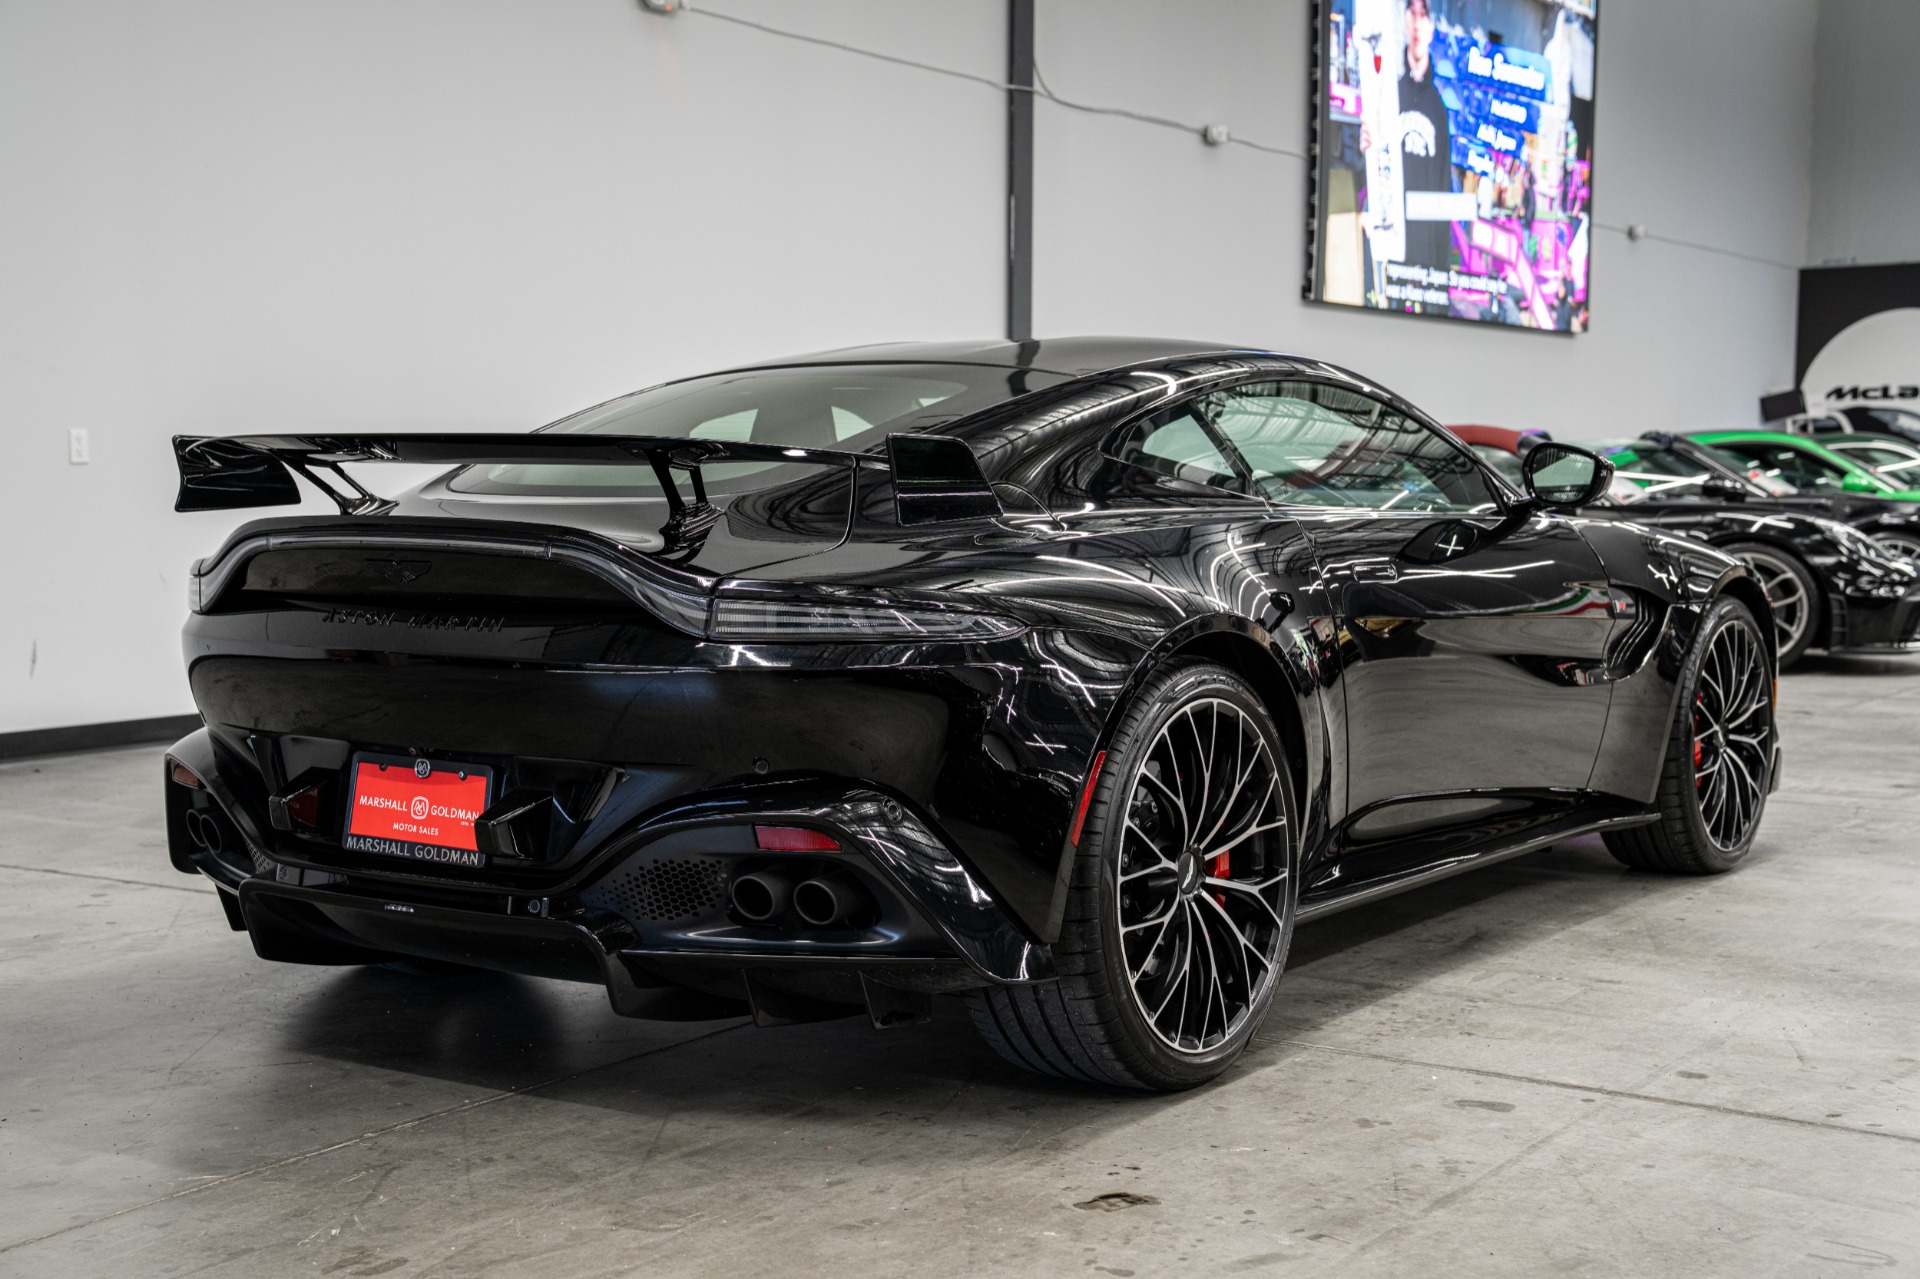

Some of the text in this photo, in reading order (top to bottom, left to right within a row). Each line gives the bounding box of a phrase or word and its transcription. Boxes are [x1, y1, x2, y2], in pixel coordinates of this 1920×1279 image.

[322, 608, 505, 632] ASTON MARTIN
[359, 795, 407, 811] MARSHALL
[430, 805, 480, 821] GOLDMAN
[392, 822, 439, 836] MOTOR SALES
[346, 836, 479, 866] MARSHALL GOLDMAN
